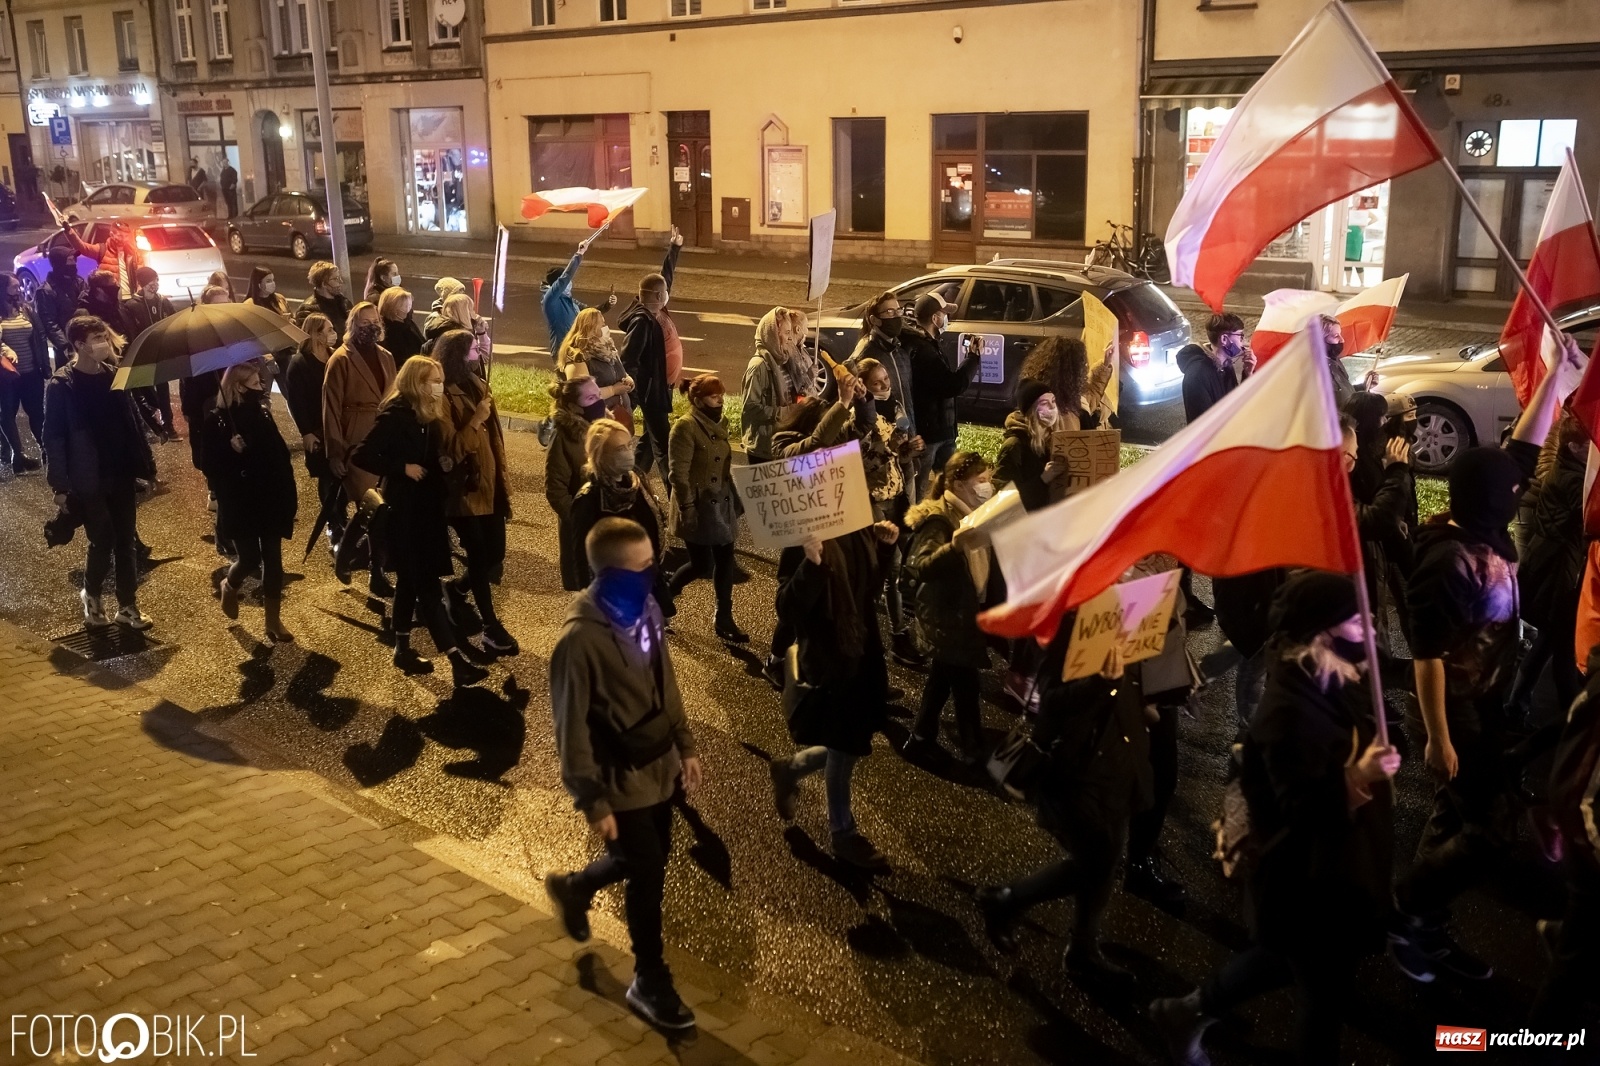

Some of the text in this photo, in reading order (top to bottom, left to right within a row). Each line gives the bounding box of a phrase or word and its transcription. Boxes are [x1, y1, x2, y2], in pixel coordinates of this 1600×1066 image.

[53, 119, 66, 137] P
[750, 450, 834, 482] ZNISZCZYŁEM
[1066, 436, 1091, 496] KOBIE
[745, 466, 846, 499] OBRAZ, TAK JAK PIS
[771, 489, 828, 517] POLSKĘ
